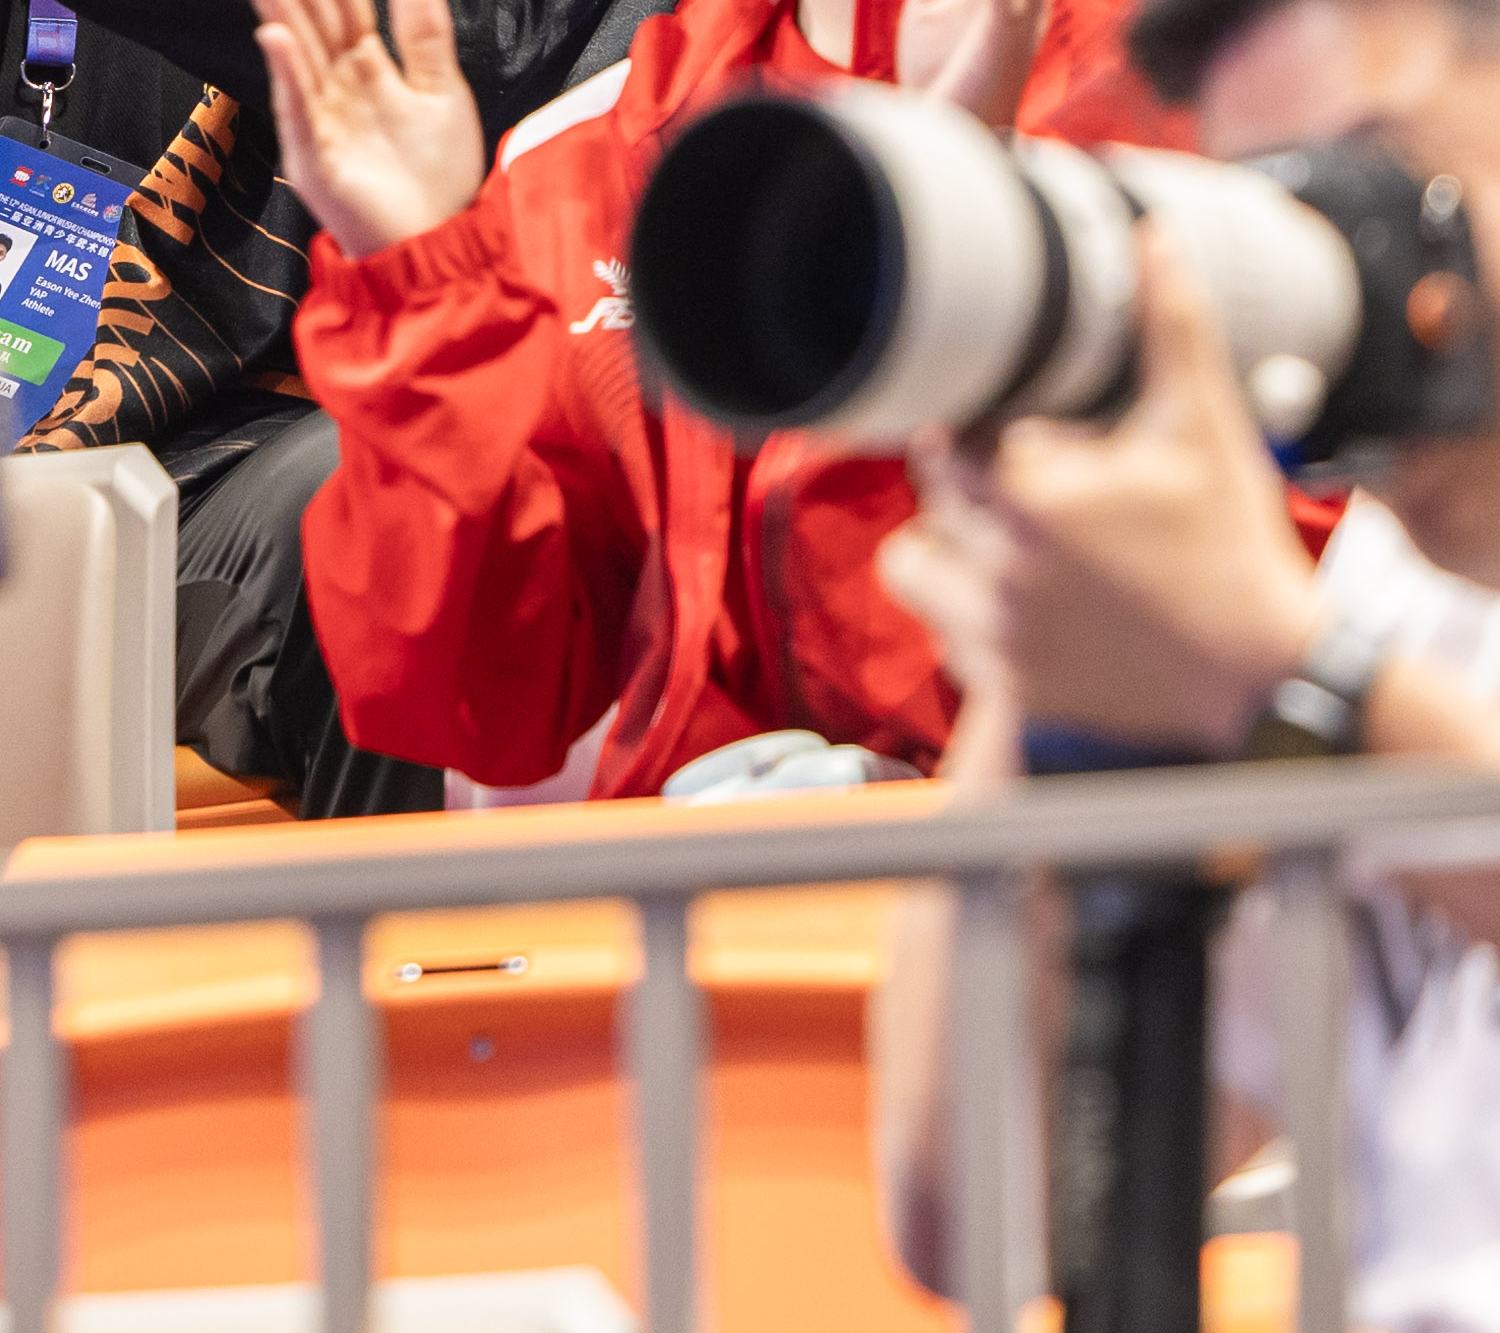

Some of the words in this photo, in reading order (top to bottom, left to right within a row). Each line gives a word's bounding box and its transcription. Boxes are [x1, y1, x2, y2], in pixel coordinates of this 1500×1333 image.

[18, 201, 38, 215] ASIAN
[36, 209, 59, 223] JUNIOR
[56, 217, 80, 232] WUSHU
[44, 249, 92, 281] MAS
[29, 286, 48, 299] YAP
[35, 276, 63, 294] Eason
[63, 286, 81, 300] Yee
[21, 298, 55, 317] Athlete
